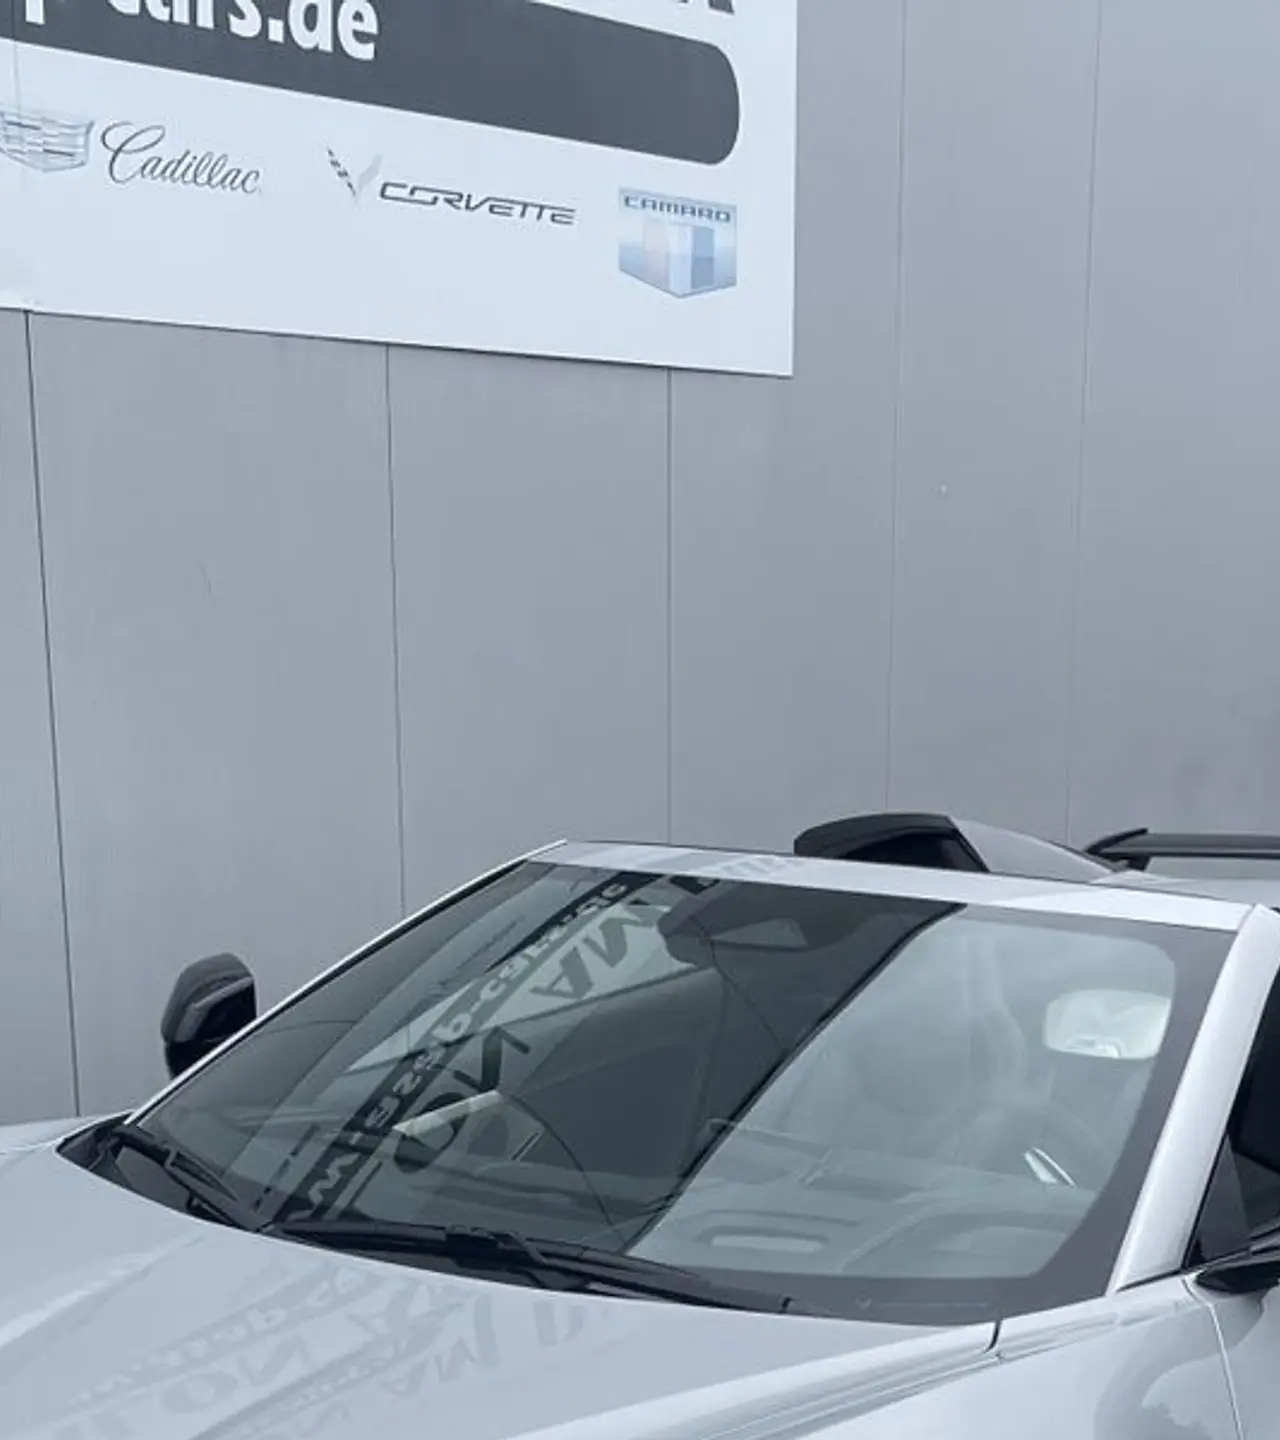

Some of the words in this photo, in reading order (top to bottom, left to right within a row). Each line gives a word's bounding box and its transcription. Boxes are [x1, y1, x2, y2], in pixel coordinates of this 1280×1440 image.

[100, 121, 261, 194] Cadillac
[378, 181, 577, 226] CORVETTE
[623, 195, 732, 223] CAMARO
